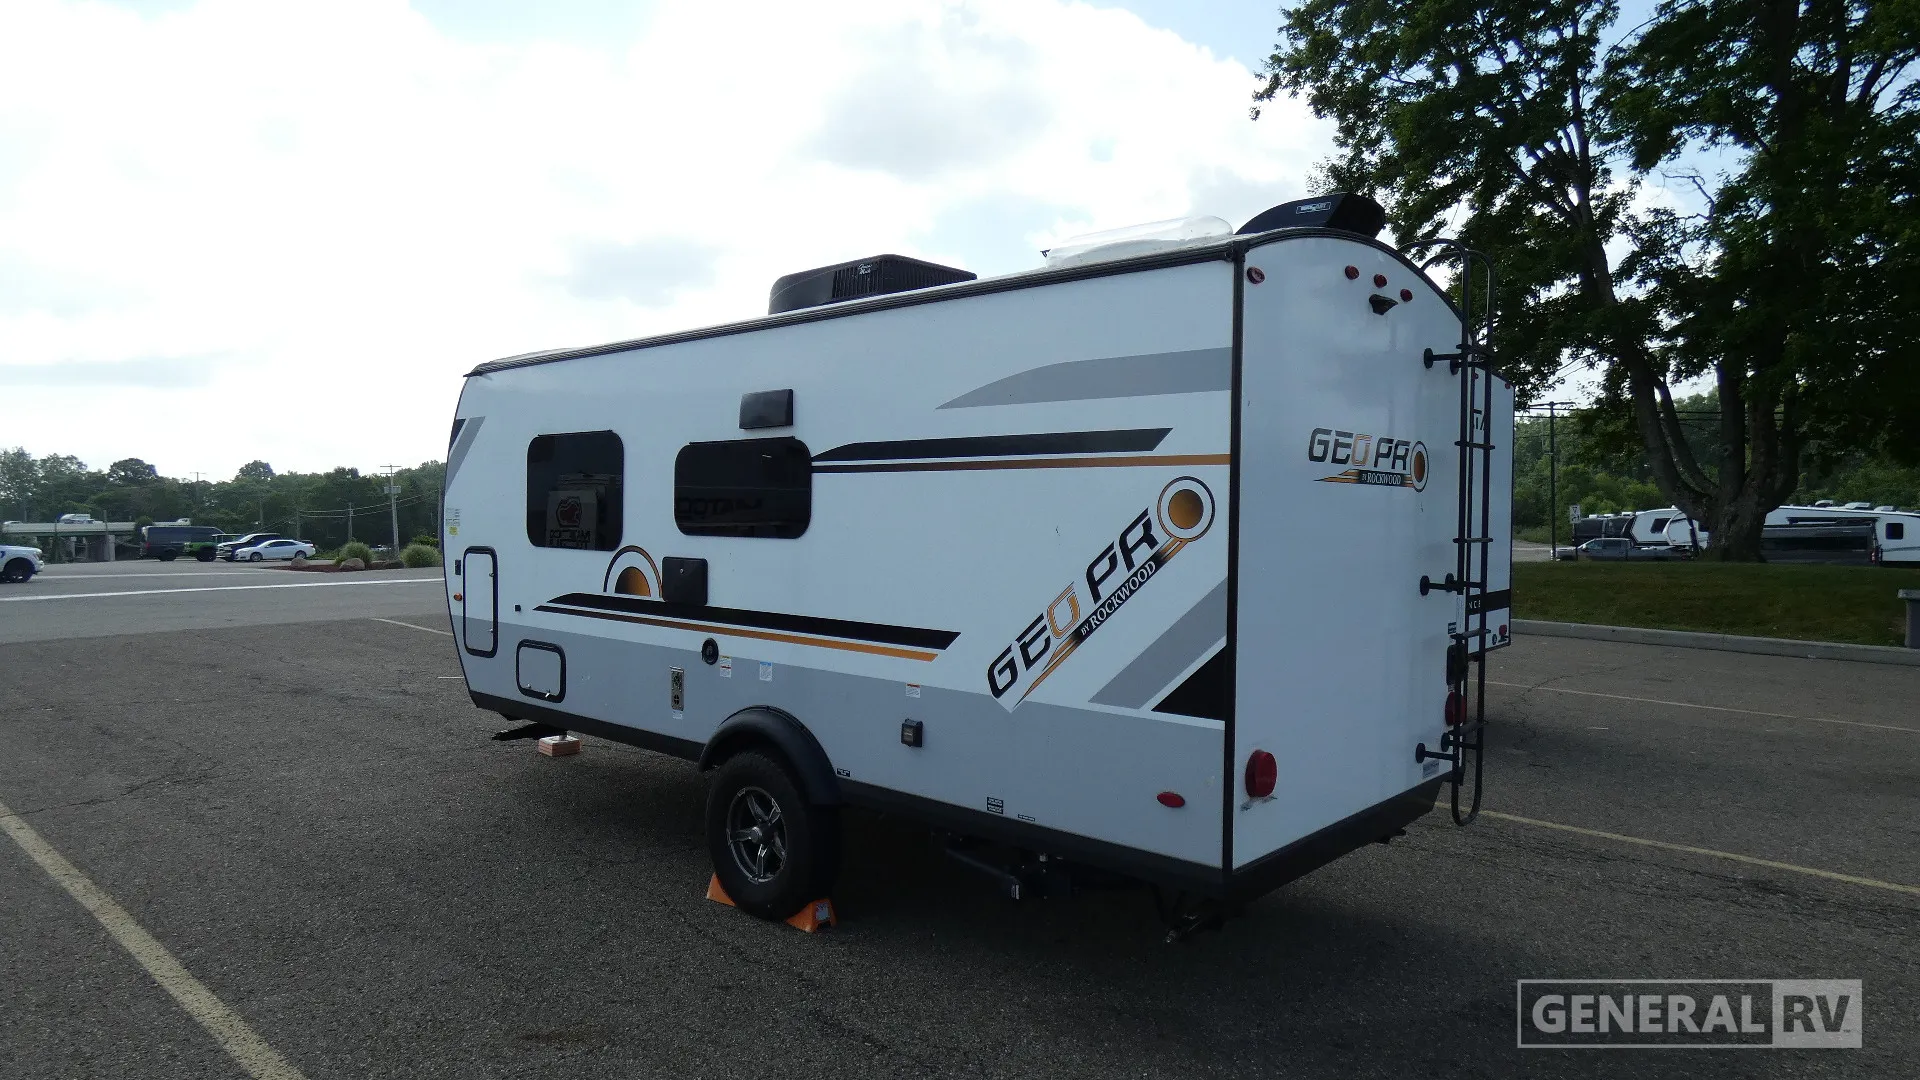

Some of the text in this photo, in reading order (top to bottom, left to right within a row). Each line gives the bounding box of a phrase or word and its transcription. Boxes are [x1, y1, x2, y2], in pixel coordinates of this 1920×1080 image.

[1308, 427, 1430, 493] GEO PRO
[1367, 473, 1402, 485] ROCKWOOD
[987, 475, 1216, 699] GEO PRO
[1080, 560, 1157, 636] BY ROCKWOOD
